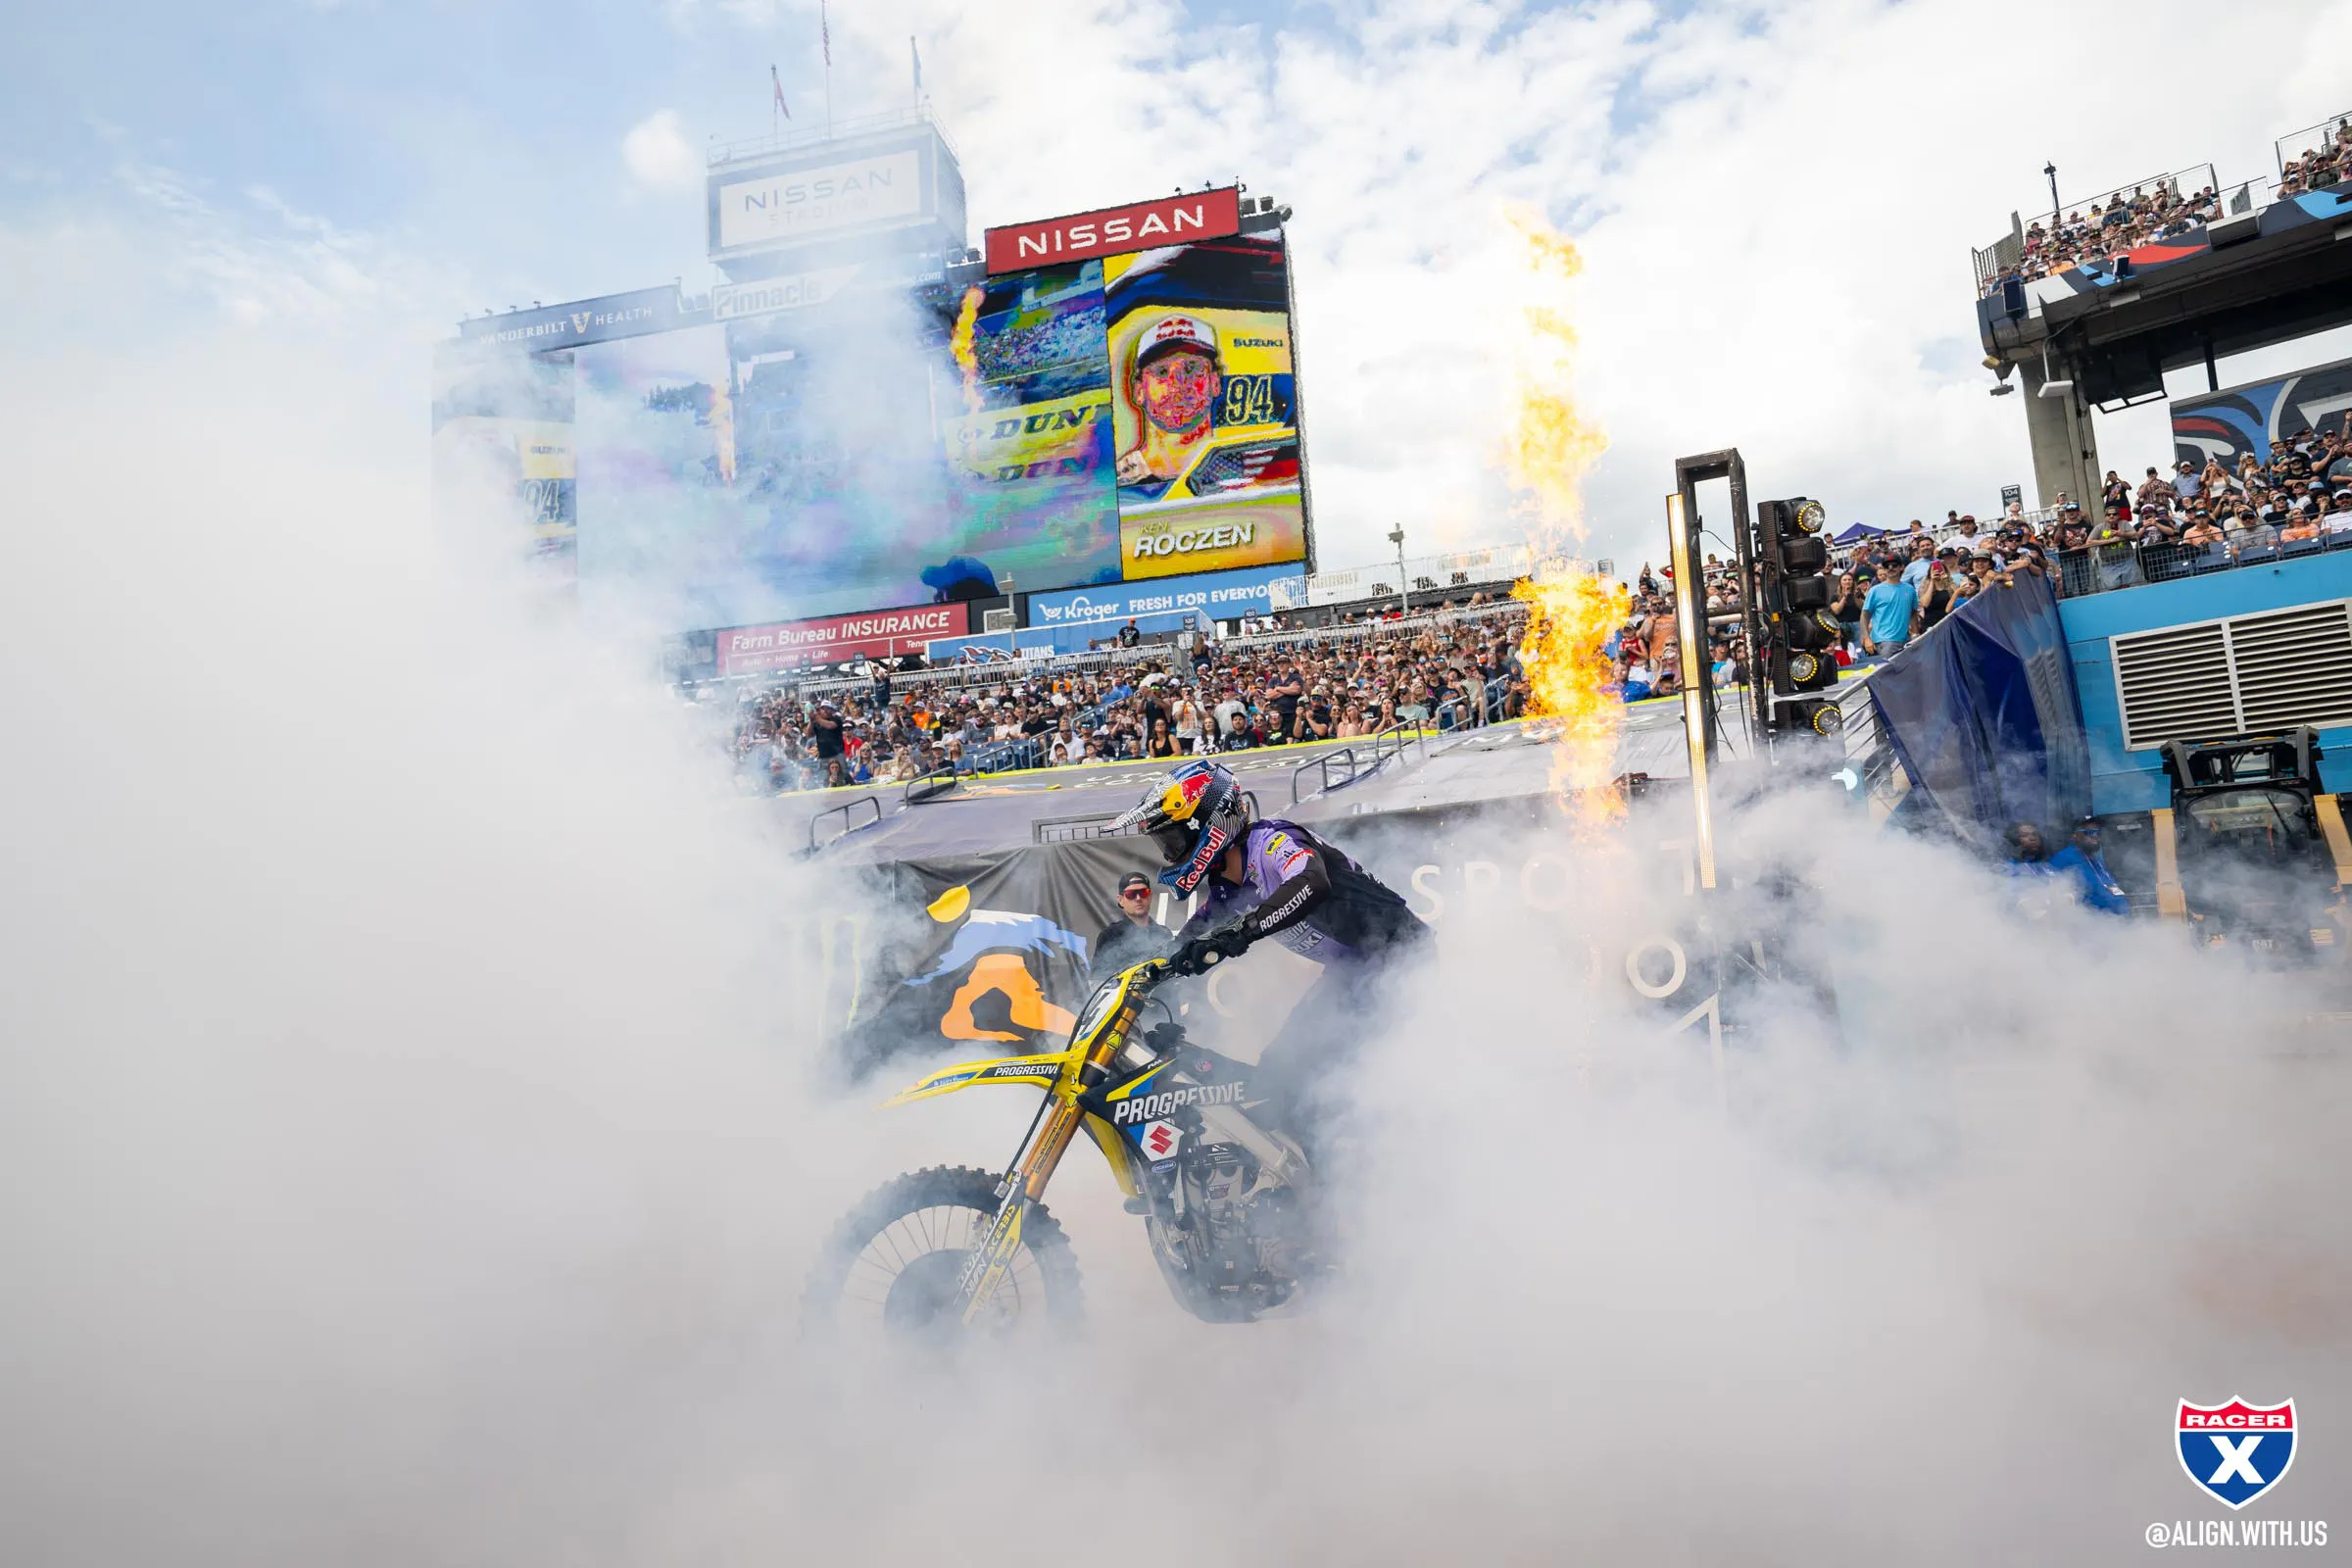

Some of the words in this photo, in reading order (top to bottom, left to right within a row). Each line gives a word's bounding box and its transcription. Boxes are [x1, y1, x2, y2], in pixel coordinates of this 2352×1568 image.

[745, 168, 894, 212] NISSAN
[1018, 205, 1203, 258] NISSAN
[715, 276, 822, 317] Pinnacle
[480, 320, 567, 344] VANDERBILT
[596, 307, 652, 326] HEALTH
[1226, 375, 1274, 424] 94
[1134, 522, 1253, 558] ROCZEN
[1065, 597, 1119, 622] Kroger
[1129, 597, 1173, 612] FRESH
[1177, 593, 1207, 608] FOR
[1211, 584, 1271, 604] EVERYO
[732, 635, 773, 652] Farm
[778, 627, 836, 645] Bureau
[842, 612, 951, 637] INSURANCE
[1020, 645, 1054, 659] TITANS
[775, 653, 800, 663] Home
[812, 650, 829, 660] Life
[1176, 858, 1207, 892] Red
[1198, 826, 1227, 862] Bull
[1259, 884, 1313, 932] ROGRESSIVE
[995, 1064, 1058, 1077] PROGRESSIV
[1114, 1081, 1245, 1126] PROGRESSIVE
[987, 1204, 1015, 1257] ACERBIS
